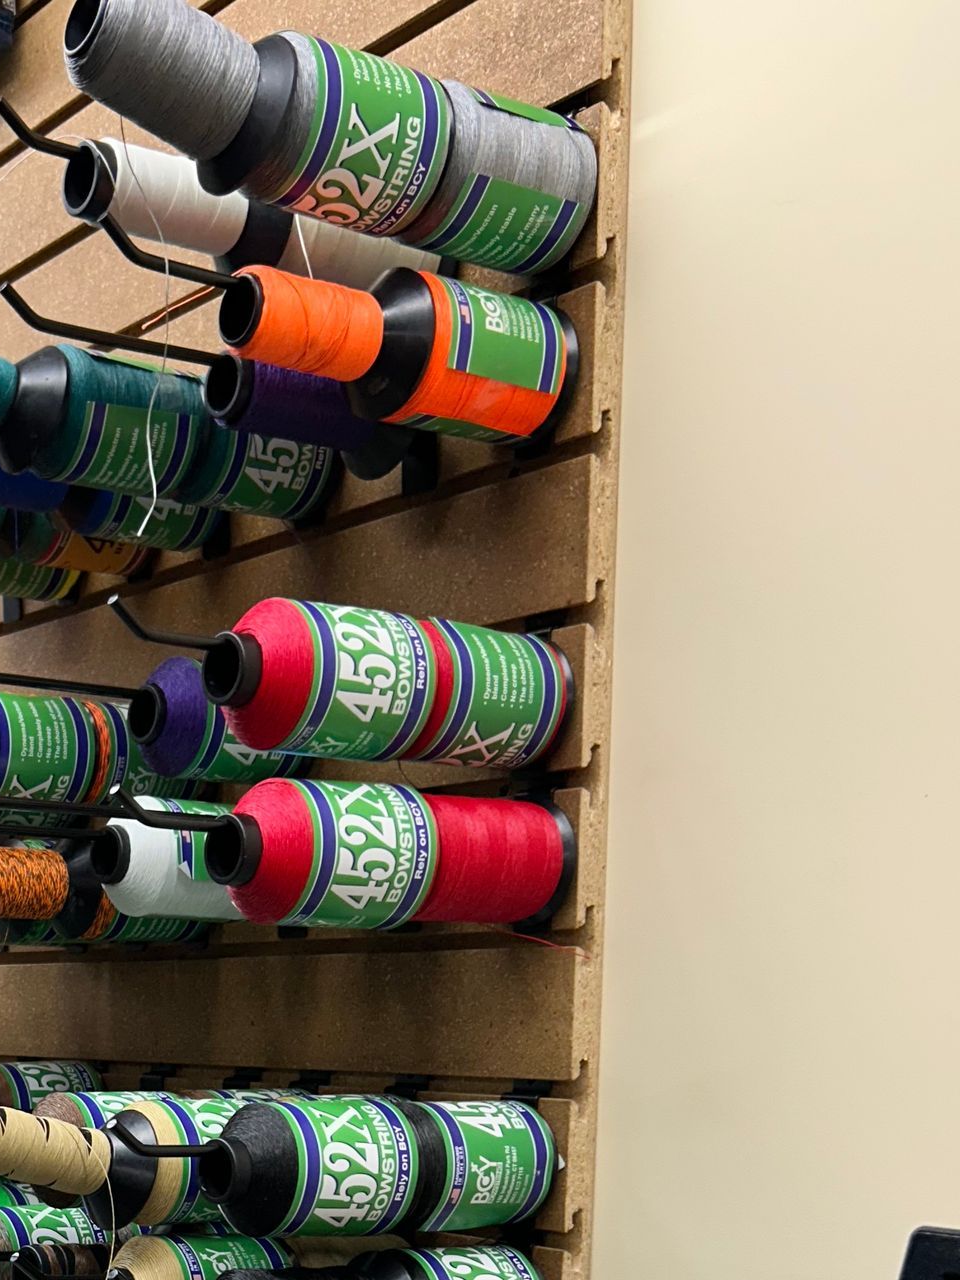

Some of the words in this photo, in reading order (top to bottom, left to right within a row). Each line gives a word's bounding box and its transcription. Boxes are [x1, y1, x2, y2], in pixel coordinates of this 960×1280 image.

[293, 103, 401, 225] 52X
[351, 117, 421, 231] OWSTRING
[372, 214, 398, 234] Rely
[396, 199, 410, 213] on
[408, 162, 428, 194] BCY
[499, 206, 517, 234] stable
[524, 205, 540, 231] many
[243, 433, 299, 494] 45
[399, 617, 417, 638] BCY
[413, 639, 424, 655] on
[416, 658, 426, 690] Rely
[408, 800, 424, 826] BCY
[330, 781, 396, 910] 452X
[374, 783, 413, 903] BOWSTRING
[418, 829, 426, 846] on
[414, 849, 428, 879] Rely
[443, 1101, 512, 1138] 45
[393, 1125, 407, 1151] BCY
[307, 1105, 379, 1227] 452X
[361, 1105, 394, 1220] BOWSTRING
[401, 1154, 408, 1170] on
[394, 1175, 408, 1201] Rely
[470, 1155, 497, 1204] BCY
[513, 1258, 524, 1270] on
